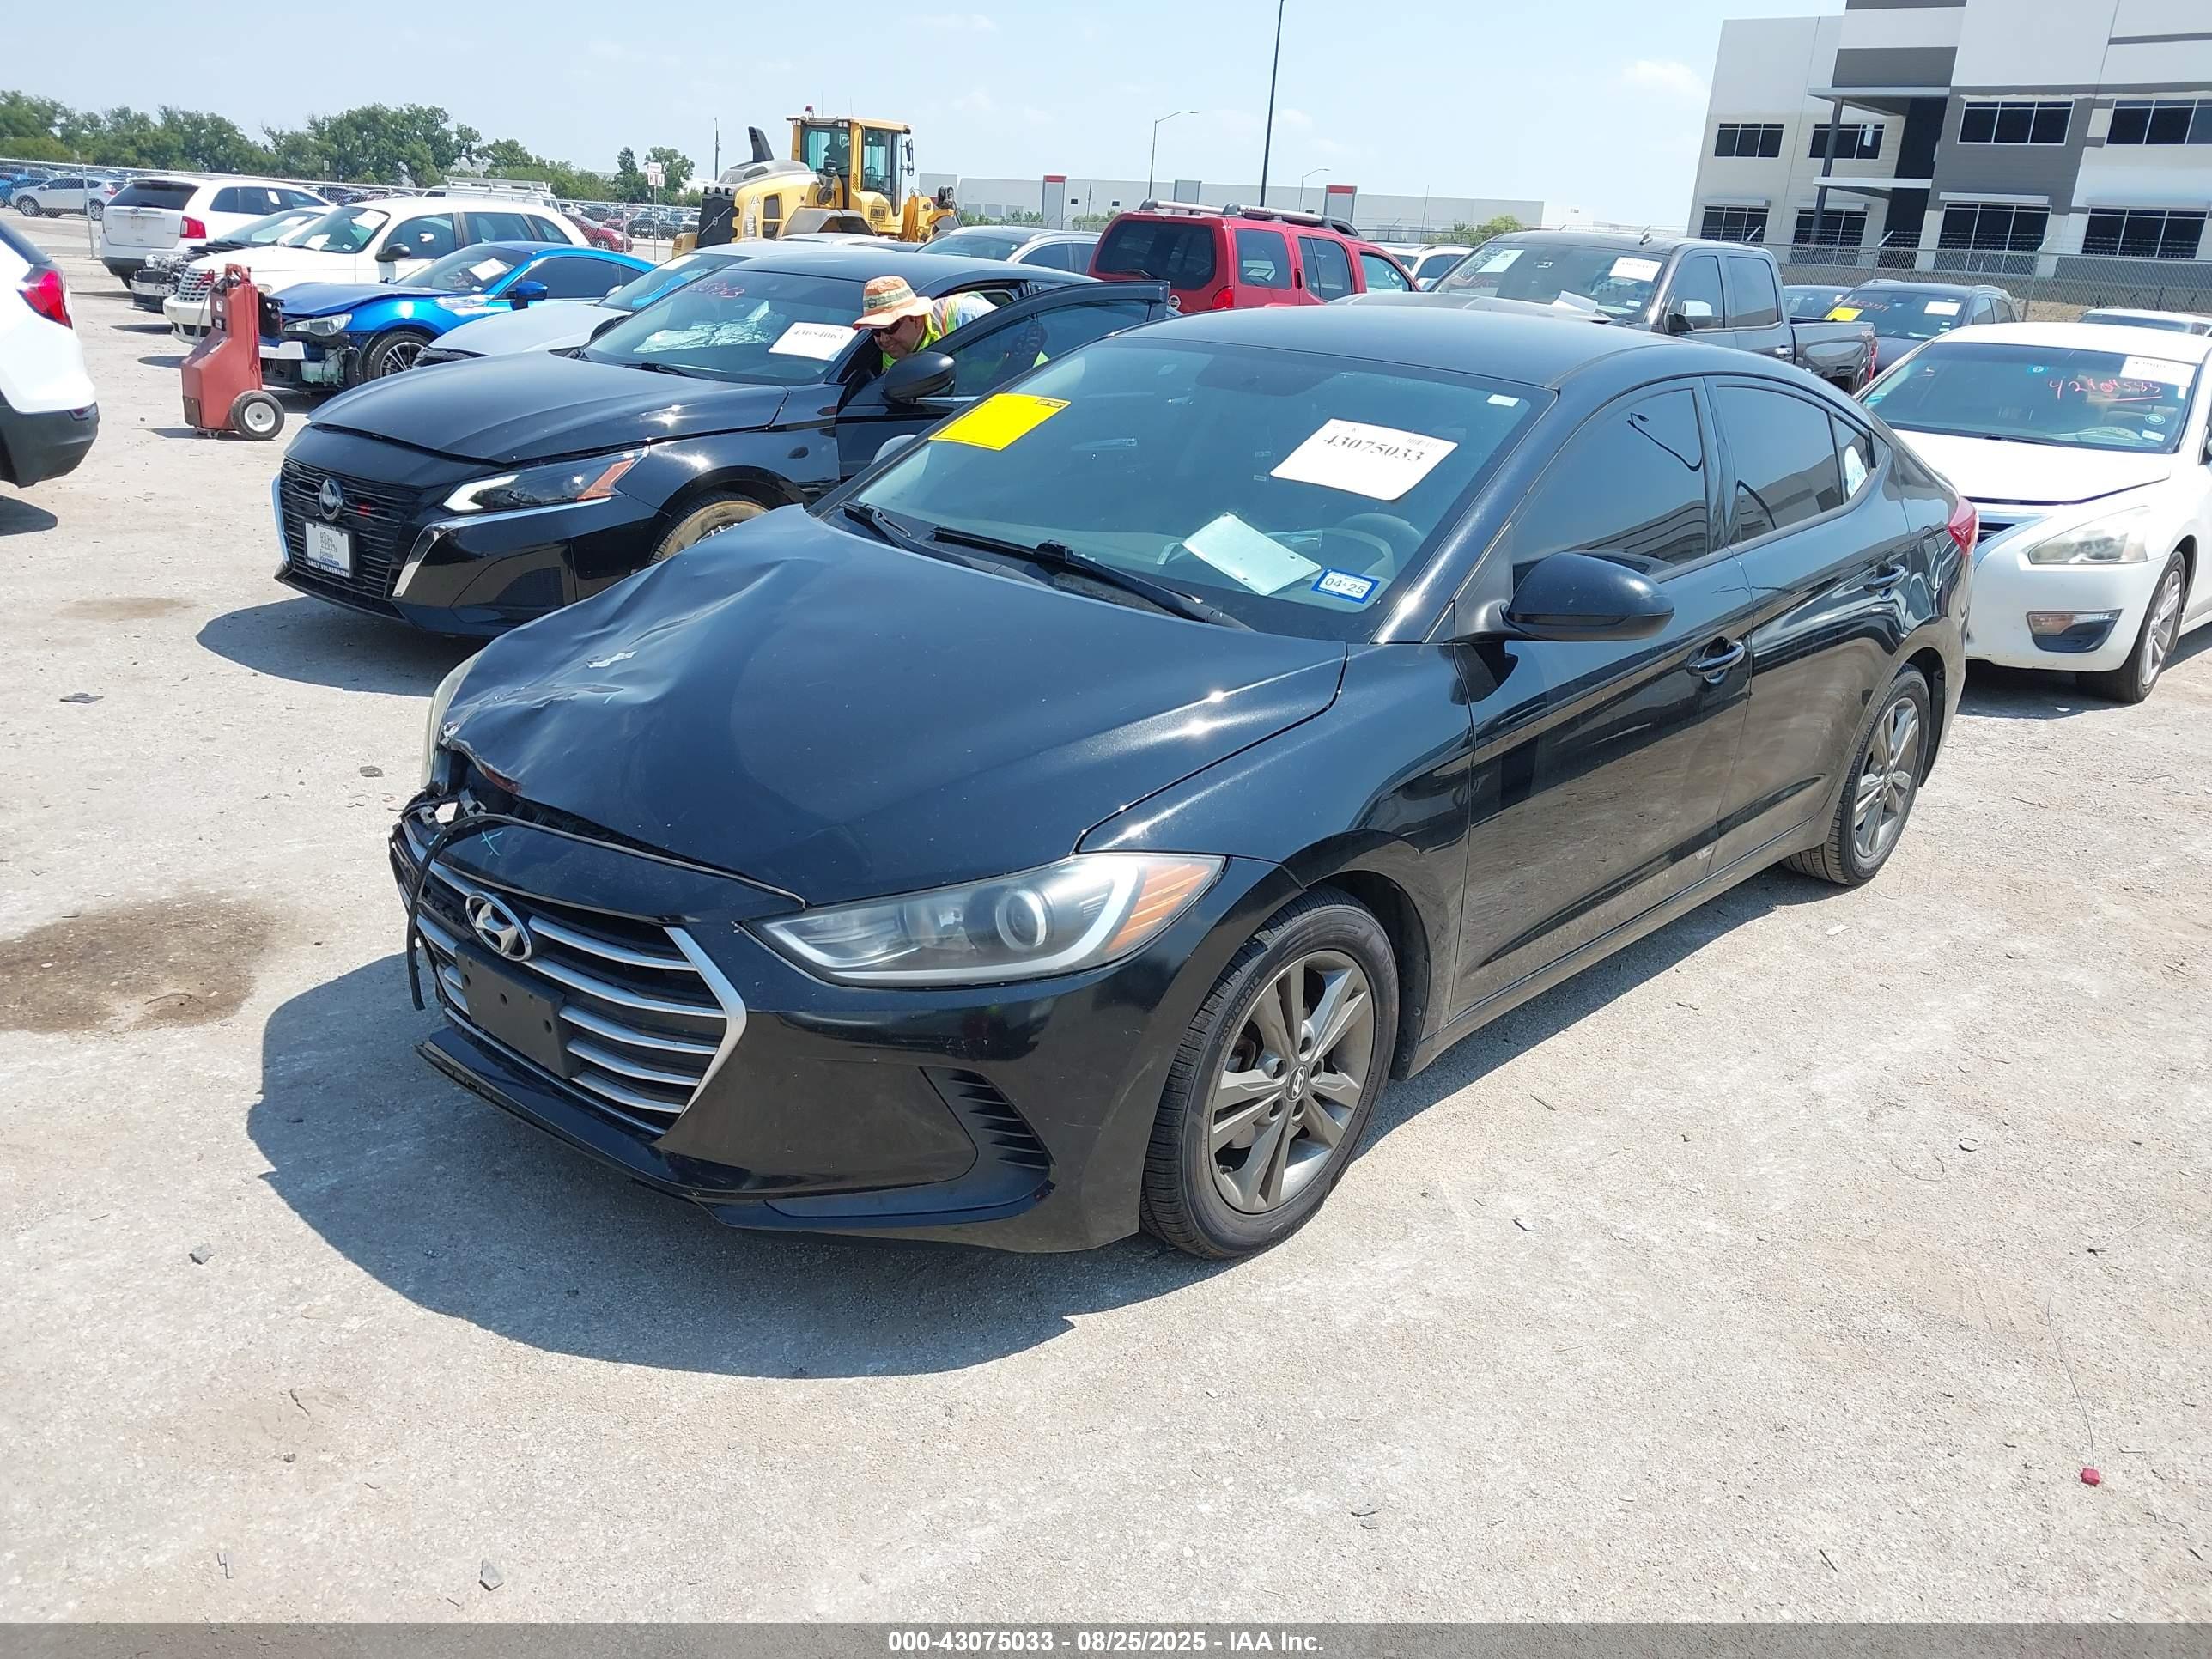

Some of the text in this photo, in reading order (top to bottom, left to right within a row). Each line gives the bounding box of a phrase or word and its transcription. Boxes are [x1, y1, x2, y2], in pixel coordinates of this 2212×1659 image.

[1323, 434, 1425, 462] 43075033
[1325, 577, 1367, 594] 04 25
